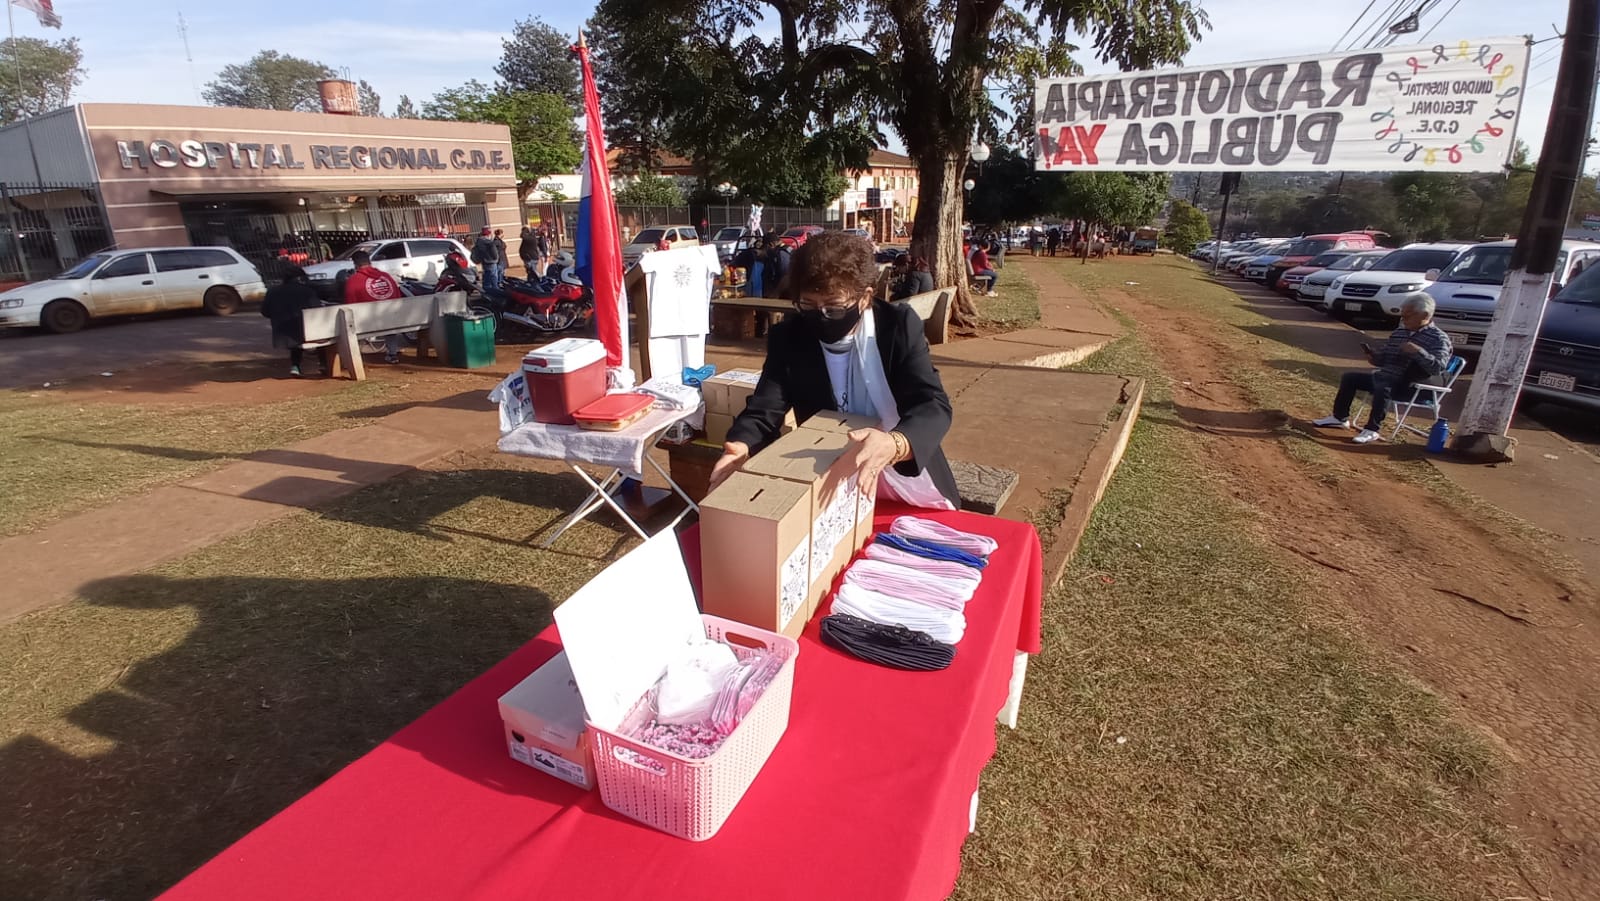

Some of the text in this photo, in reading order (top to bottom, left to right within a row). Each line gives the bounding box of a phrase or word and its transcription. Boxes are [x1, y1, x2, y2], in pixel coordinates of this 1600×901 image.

[116, 137, 511, 170] HOSPITAL REGIONAL C.D.E.
